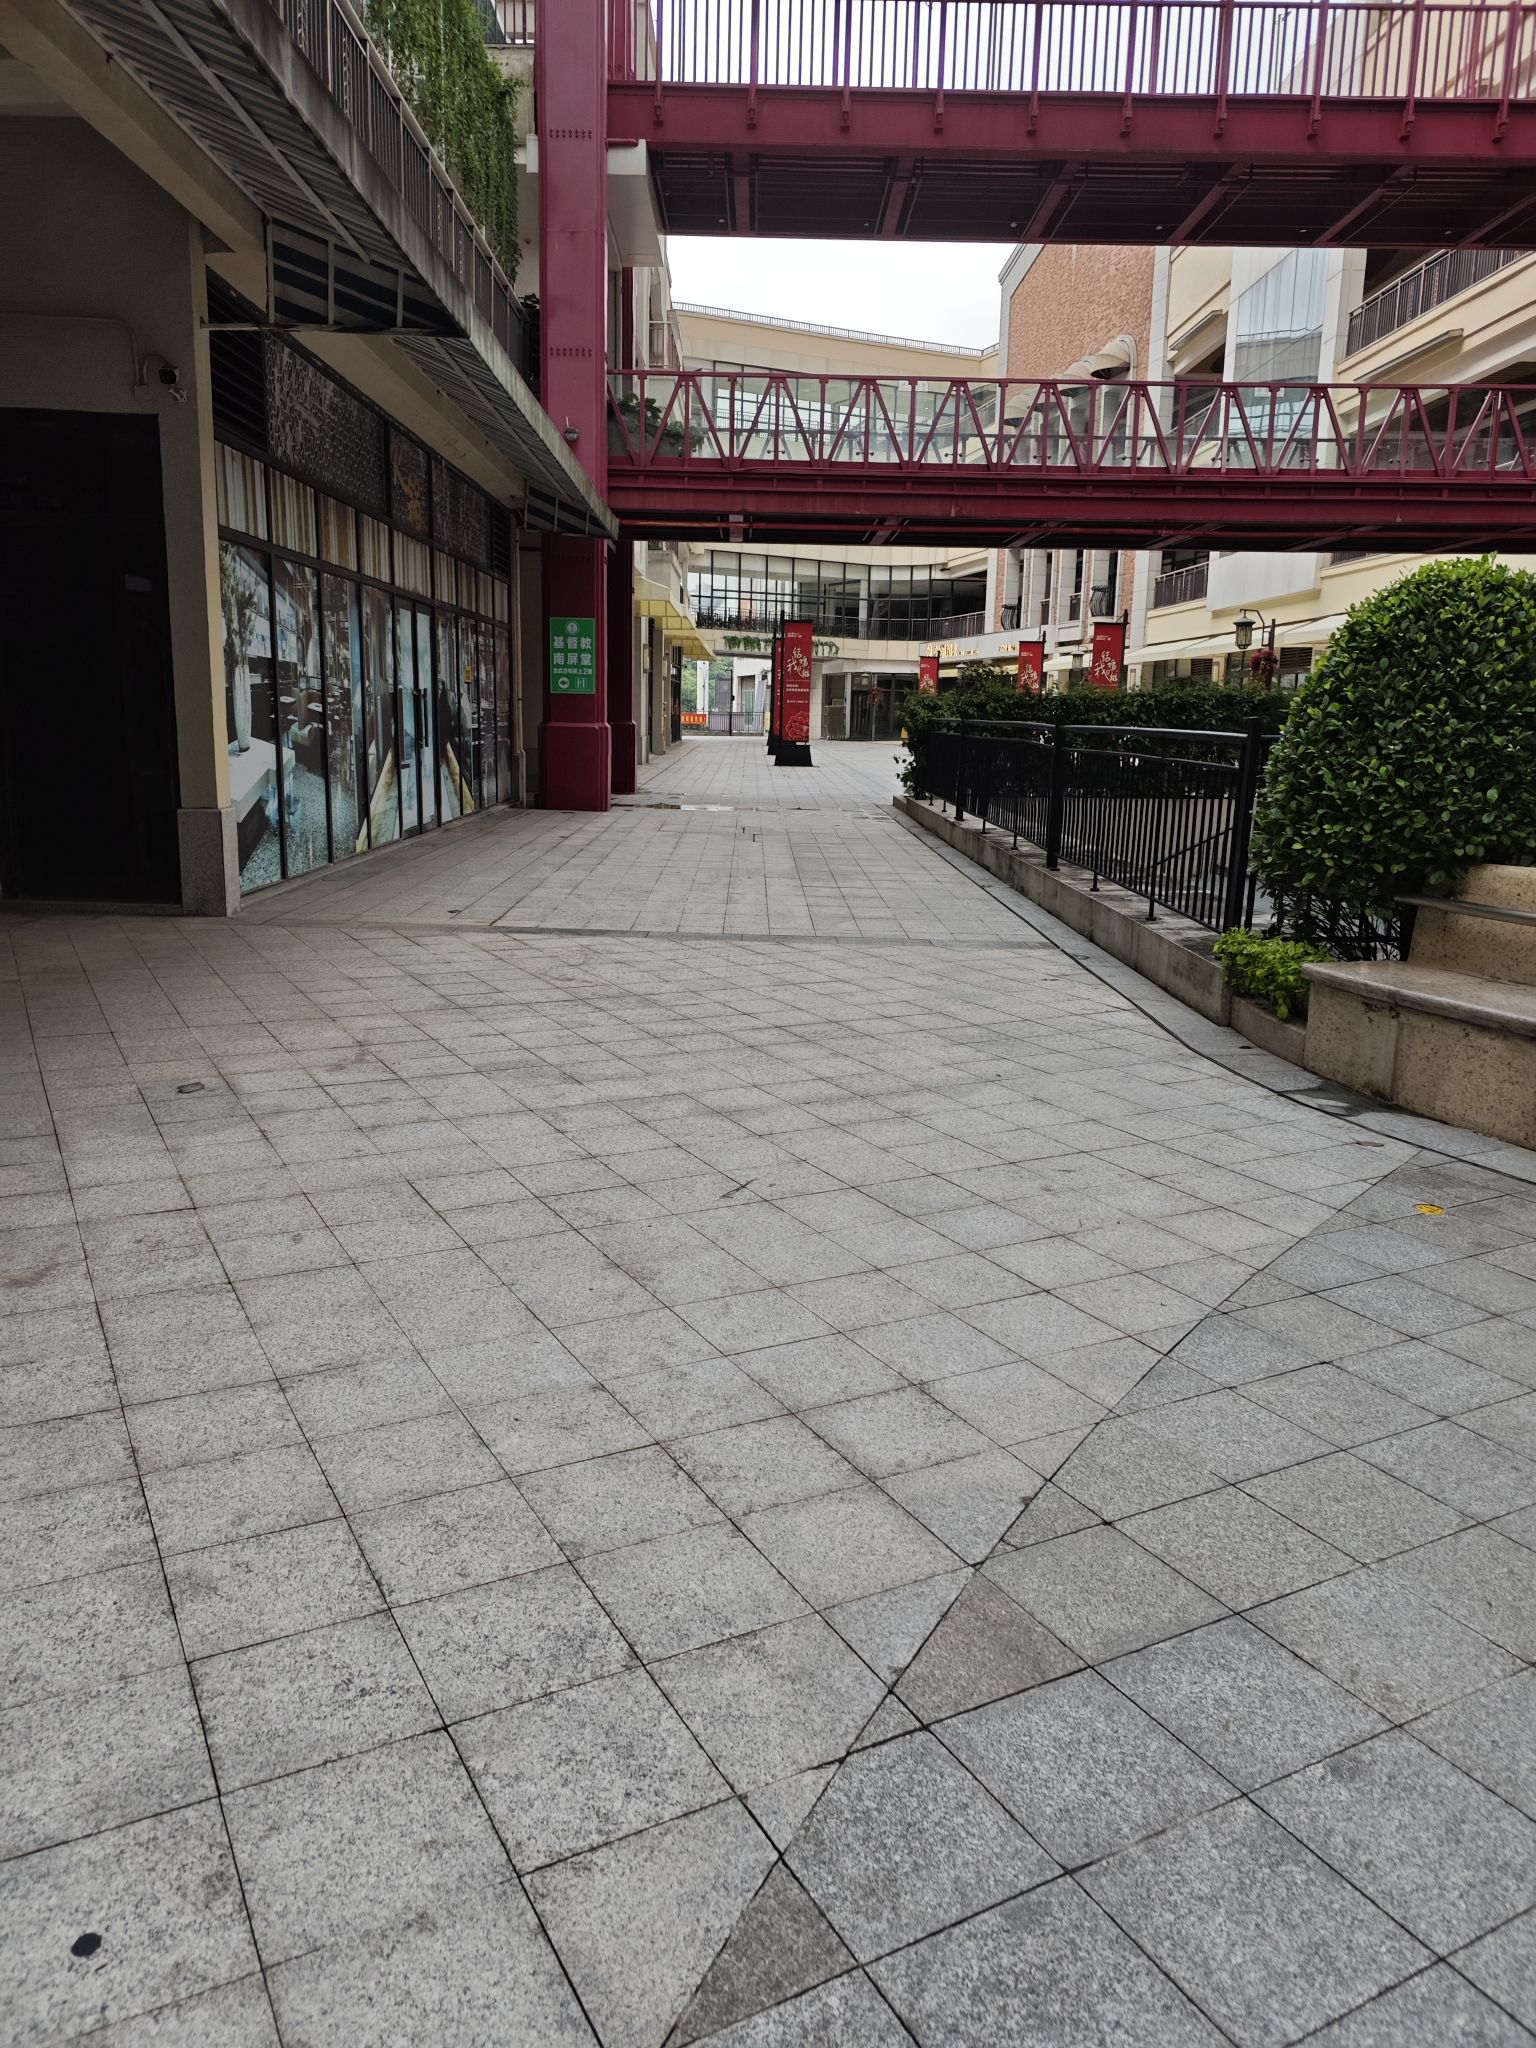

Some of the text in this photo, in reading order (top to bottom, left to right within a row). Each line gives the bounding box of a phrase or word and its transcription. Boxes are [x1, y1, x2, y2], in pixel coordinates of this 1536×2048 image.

[553, 636, 592, 650] 基督教
[553, 652, 592, 665] 南屏堂
